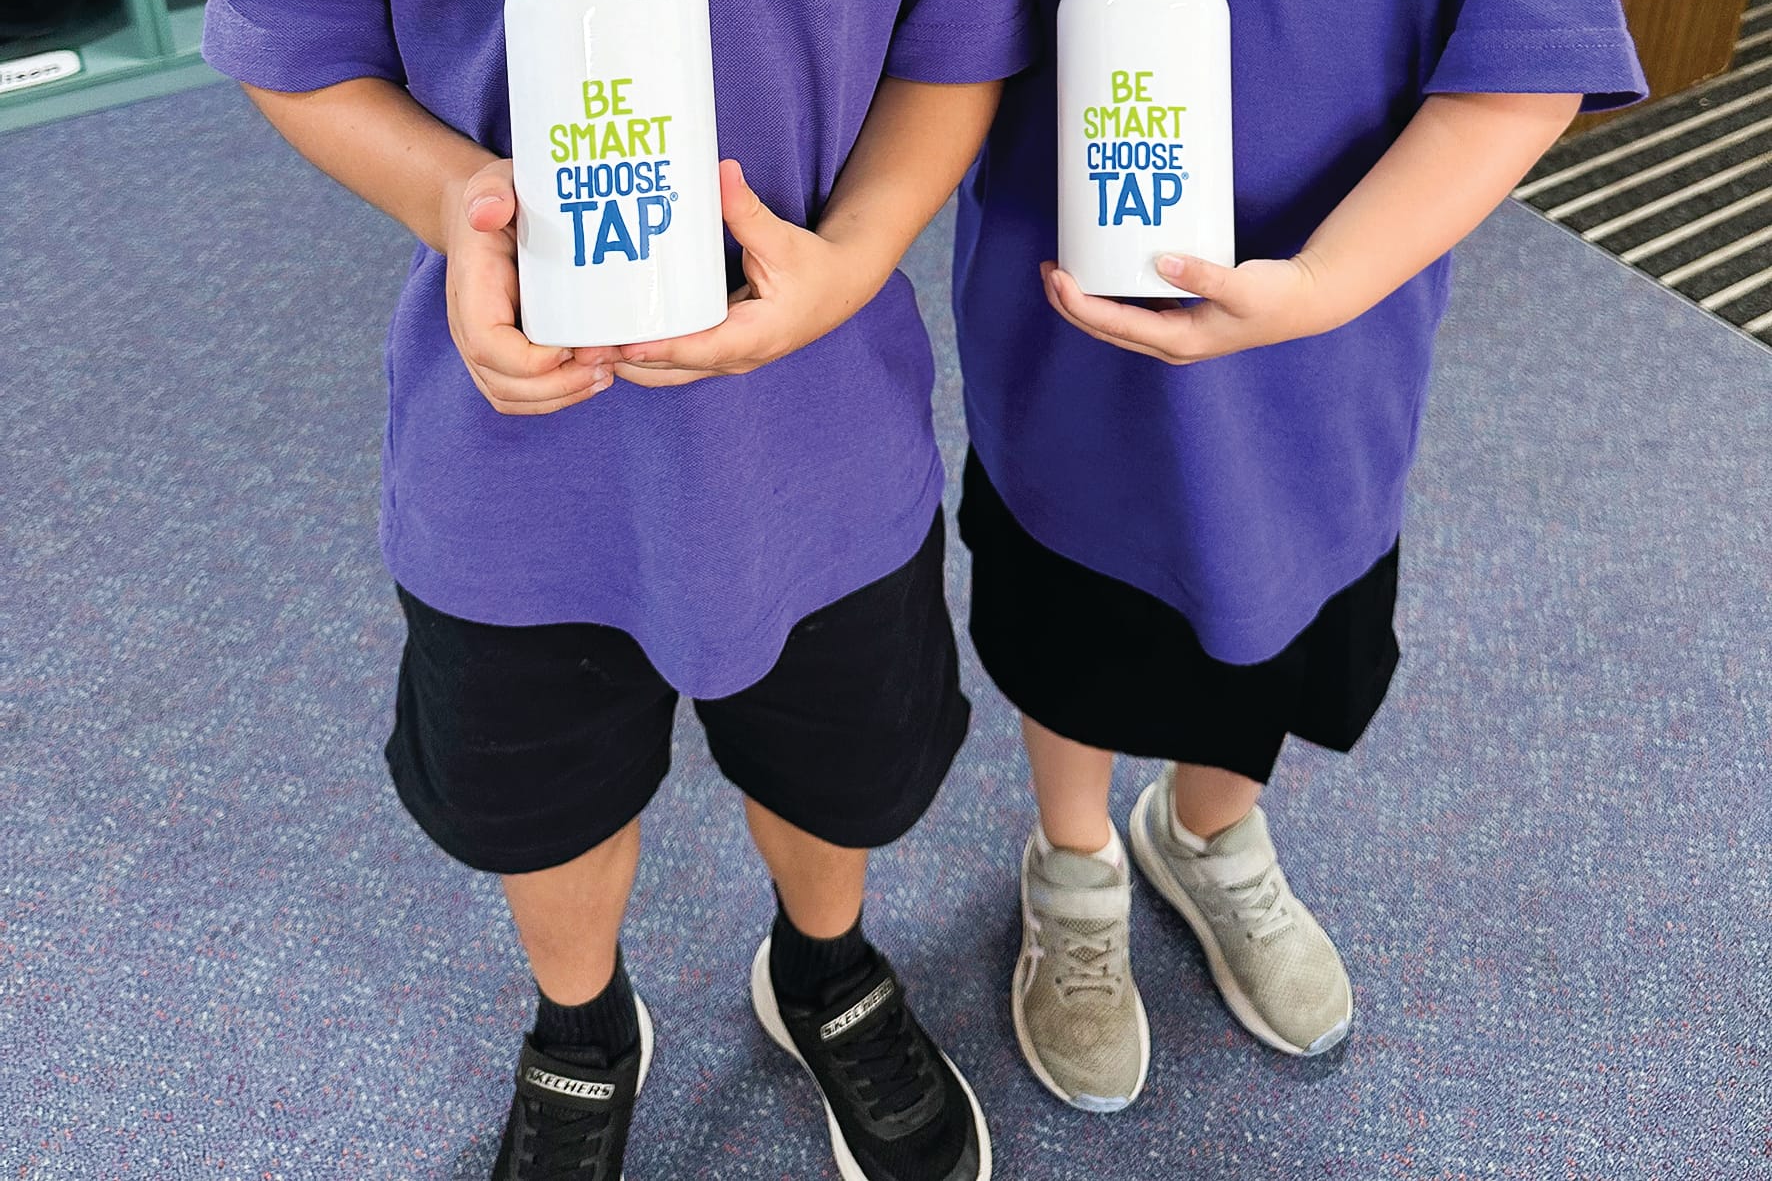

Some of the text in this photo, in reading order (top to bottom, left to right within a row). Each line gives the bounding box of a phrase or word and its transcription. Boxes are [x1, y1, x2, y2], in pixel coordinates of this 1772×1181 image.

[582, 78, 633, 120] BE
[1111, 70, 1154, 104] BE
[550, 115, 672, 163] SMART
[1083, 106, 1188, 140] SMART
[1087, 141, 1184, 170] CHOOSE
[556, 160, 671, 200] CHOOSE
